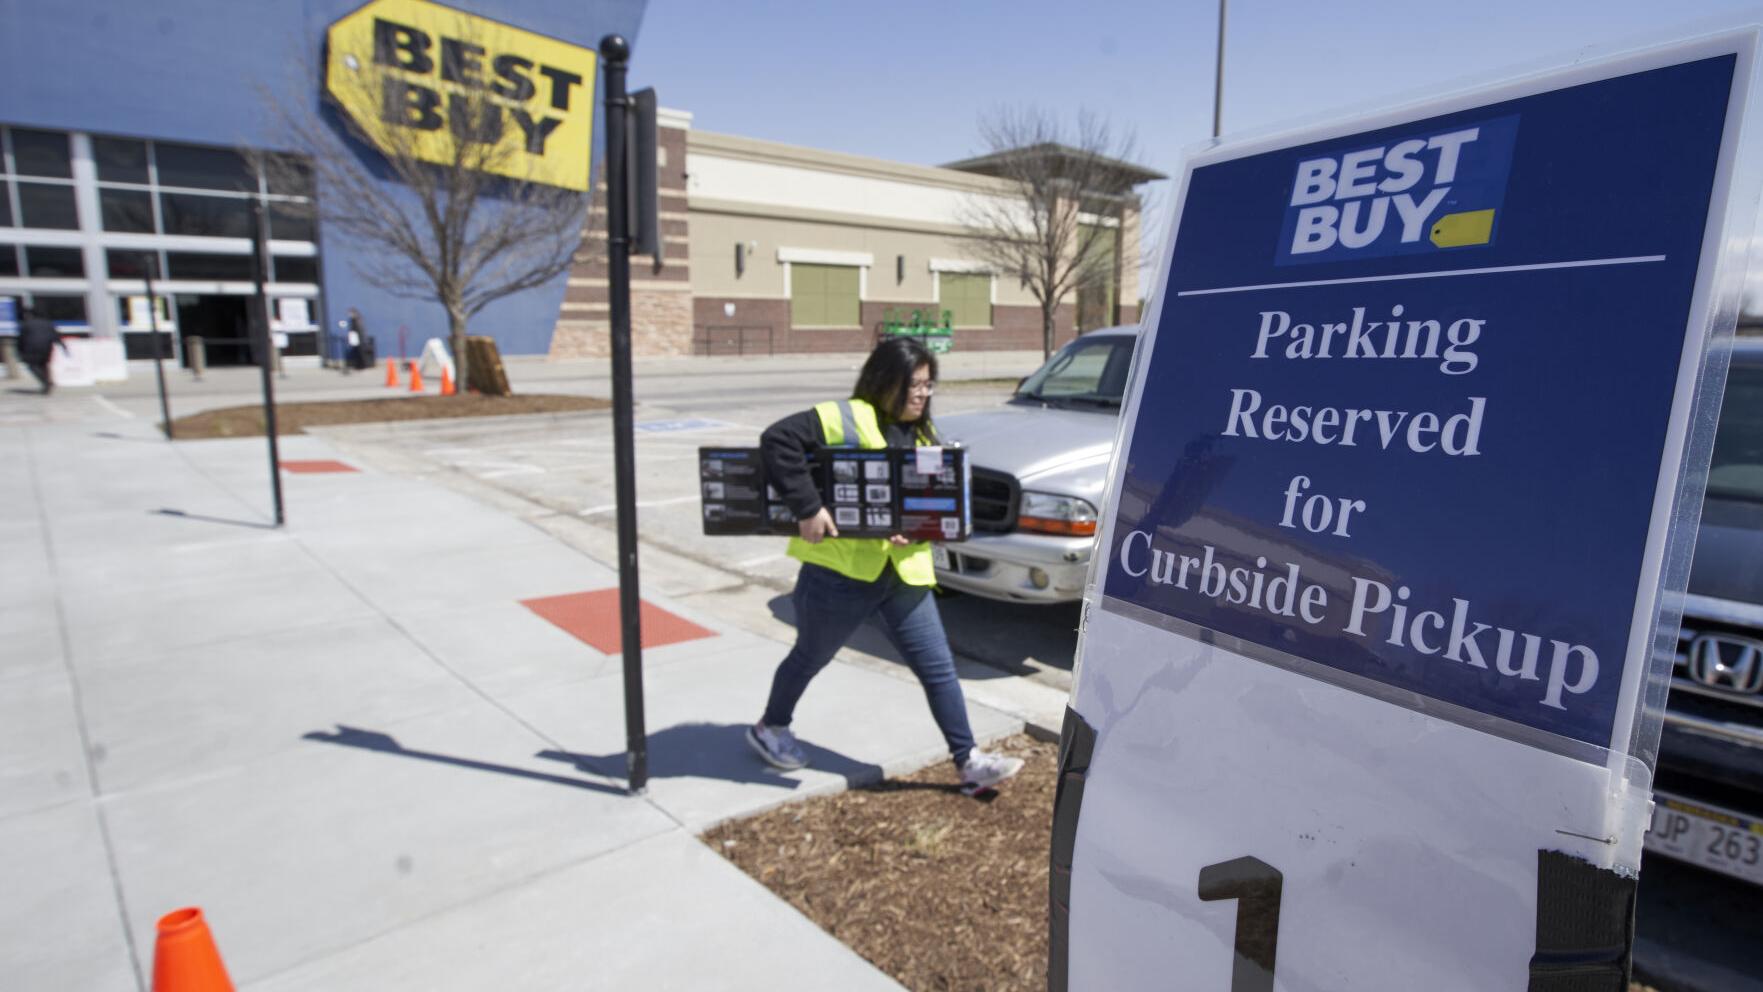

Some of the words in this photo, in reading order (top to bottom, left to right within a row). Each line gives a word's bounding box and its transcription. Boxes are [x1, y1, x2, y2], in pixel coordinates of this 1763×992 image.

[373, 17, 583, 112] BEST
[382, 73, 564, 156] BUY
[1290, 127, 1480, 207] BEST
[1290, 187, 1453, 256] BUY
[1249, 304, 1487, 376] Parking
[1220, 388, 1487, 457] Reserved
[1277, 474, 1367, 539] for
[1119, 529, 1328, 625] Curbside
[1341, 575, 1600, 711] Pickup
[1651, 810, 1691, 843] JP
[1707, 825, 1761, 866] 263
[1197, 854, 1284, 992] 1
